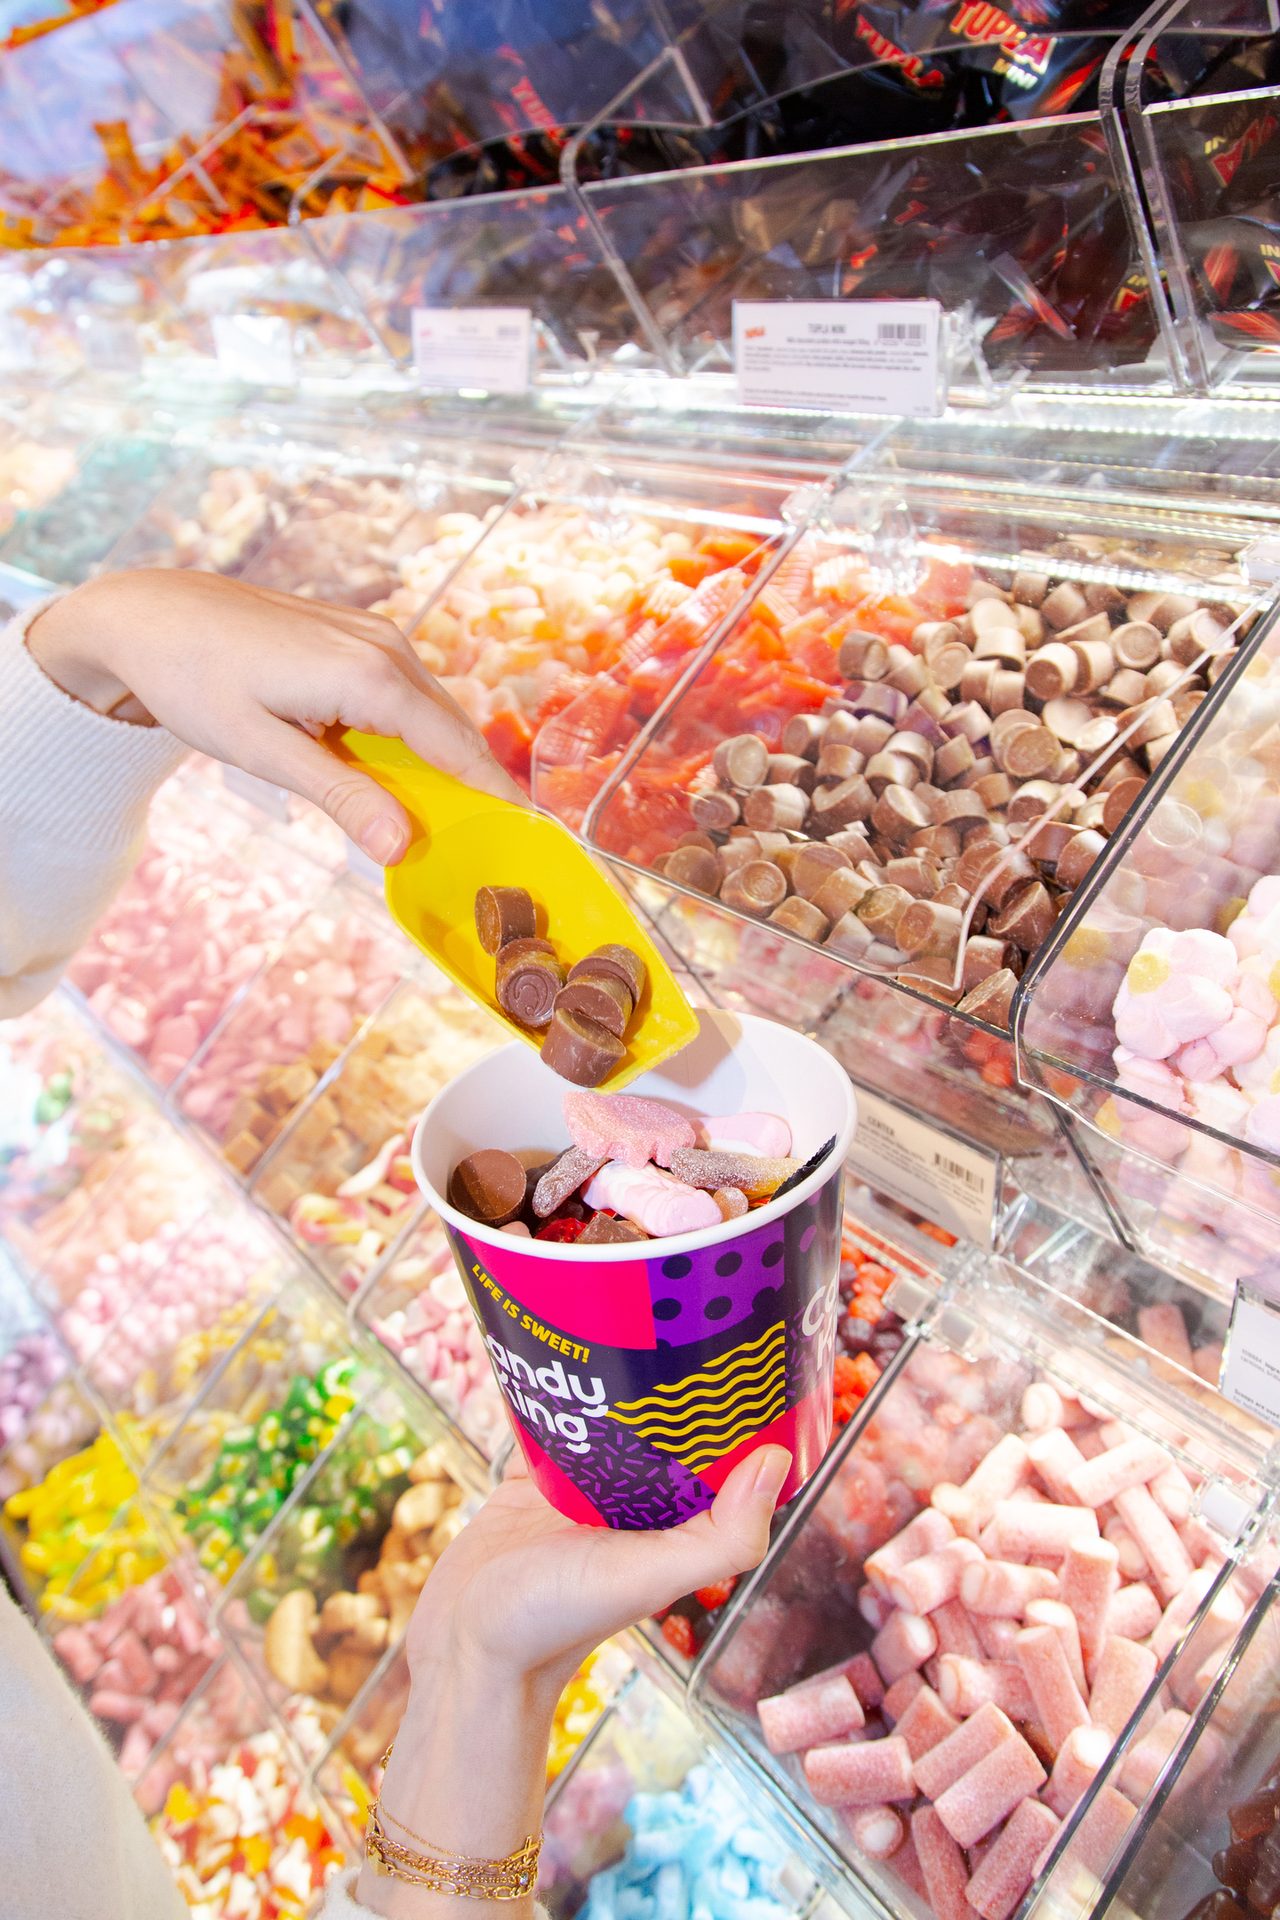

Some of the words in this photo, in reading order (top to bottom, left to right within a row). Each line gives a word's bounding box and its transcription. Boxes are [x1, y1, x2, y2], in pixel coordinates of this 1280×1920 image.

[950, 0, 1057, 75] TUPLA
[472, 1264, 503, 1302] LIFE
[502, 1298, 521, 1319] IS
[520, 1314, 591, 1364] SWEET!
[485, 1334, 609, 1418] andy
